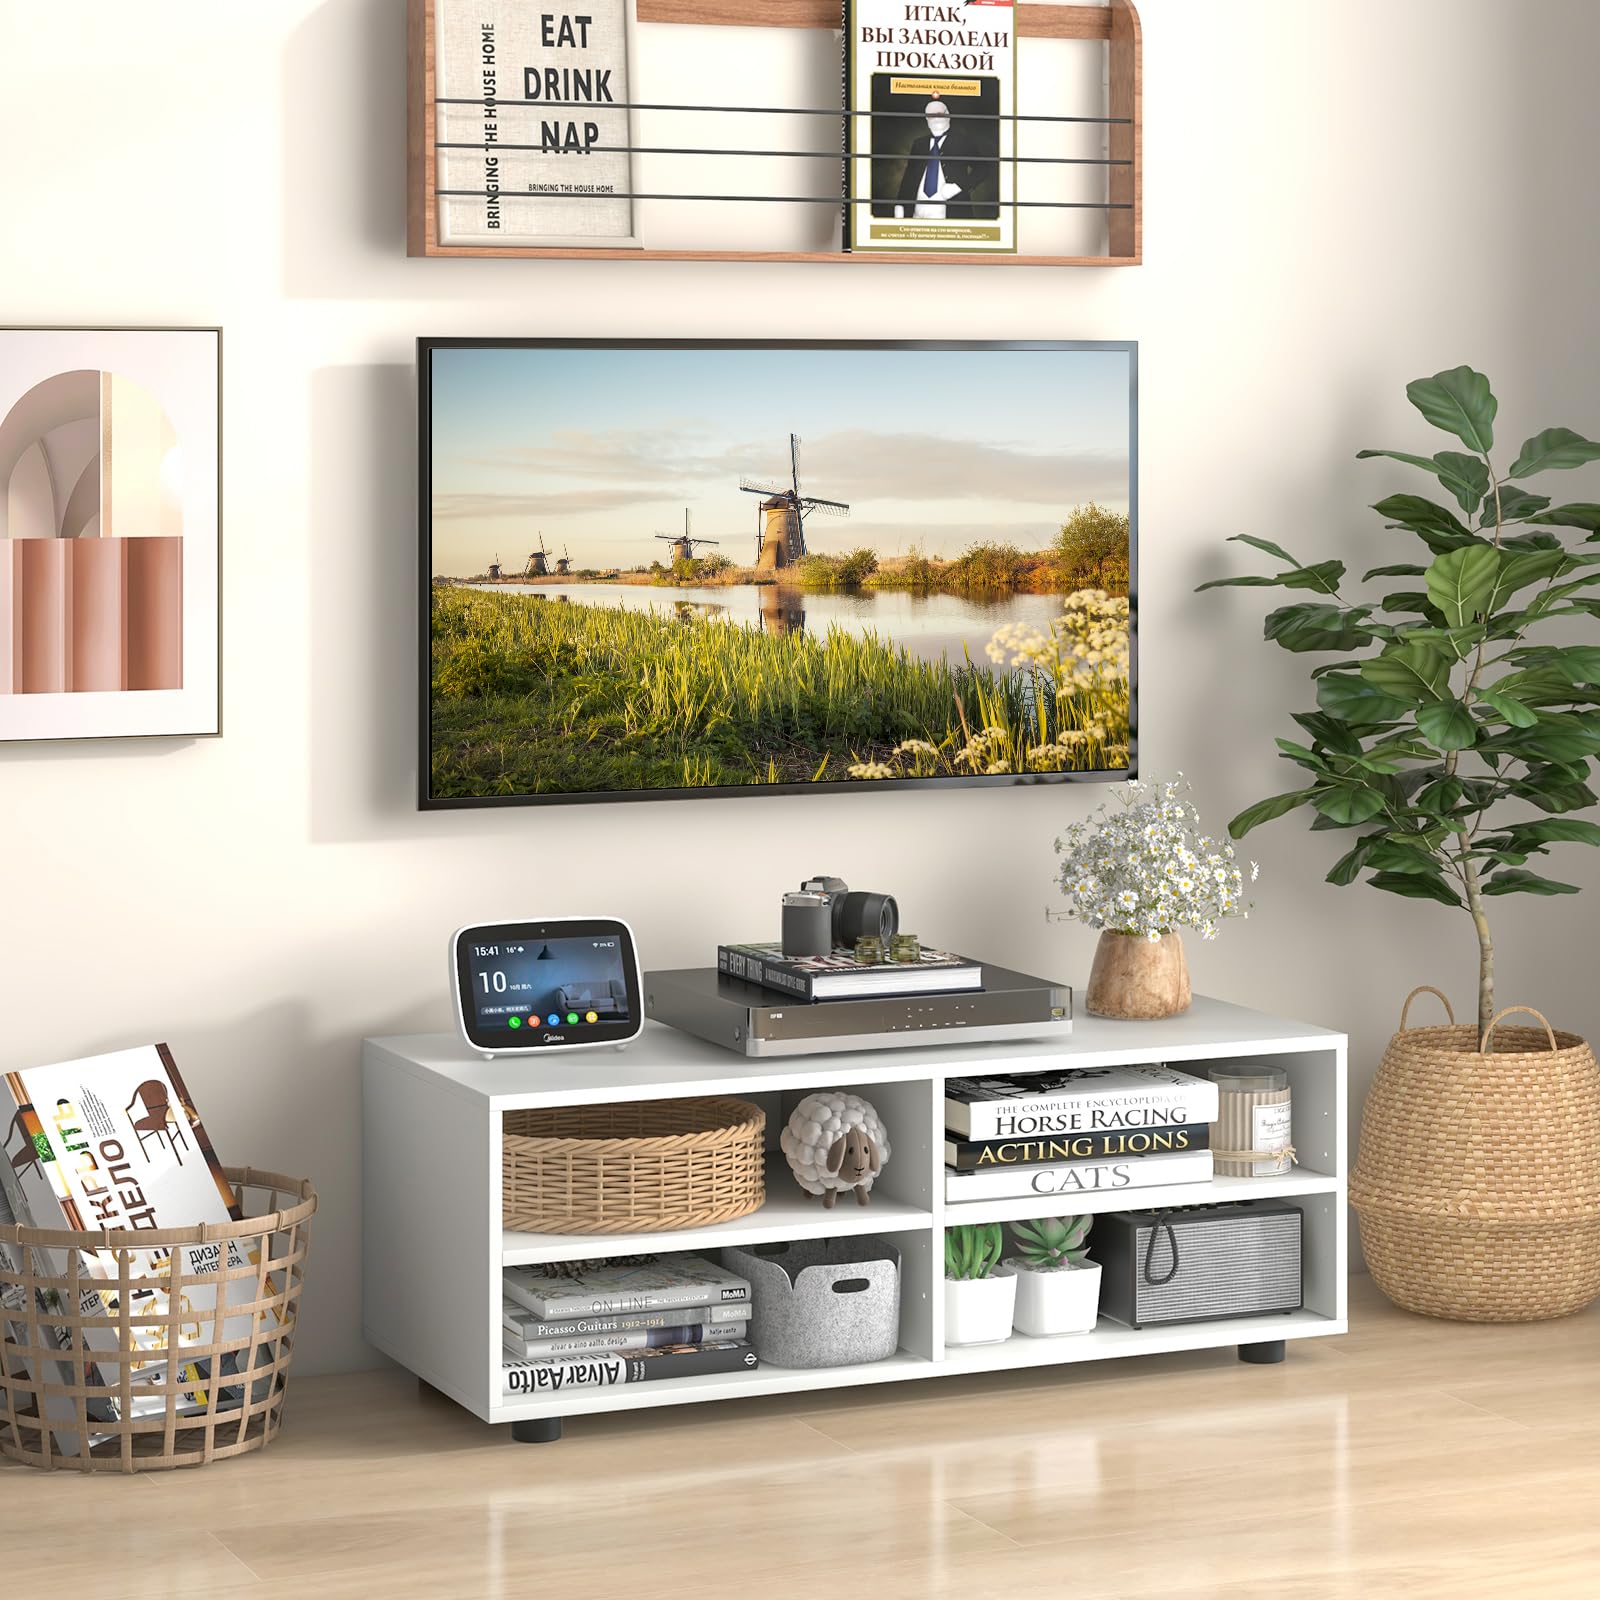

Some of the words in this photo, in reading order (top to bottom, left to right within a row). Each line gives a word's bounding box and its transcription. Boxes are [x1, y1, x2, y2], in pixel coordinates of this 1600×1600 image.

[904, 5, 967, 26] ИТАК,
[541, 14, 592, 48] EAT
[862, 27, 893, 44] ВЫ
[899, 28, 1009, 48] ЗАБОЛЕЛИ
[481, 23, 495, 64] HOME
[876, 51, 994, 71] ПРОКАЗОЙ
[483, 69, 497, 118] HOUSE
[524, 67, 613, 102] DRINK
[485, 123, 497, 152] THE
[541, 121, 599, 155] NAP
[485, 157, 500, 229] BRINGING
[528, 183, 559, 192] BRINGING
[560, 184, 573, 193] THE
[574, 185, 594, 193] HOUSE
[596, 185, 614, 193] HOME
[474, 946, 499, 956] 15:41
[478, 971, 507, 993] 10
[995, 1105, 1019, 1116] THE
[1022, 1100, 1082, 1114] COMPLETE
[1086, 1095, 1170, 1109] ENCYCLOPEDIA
[995, 1113, 1082, 1136] HORSE
[1091, 1106, 1188, 1130] RACING
[977, 1138, 1095, 1166] ACTING
[1104, 1129, 1190, 1155] LIONS
[99, 1139, 158, 1231] ДЕЛО
[1030, 1163, 1132, 1194] CATS
[188, 1240, 238, 1266] ДИЗАН
[193, 1256, 243, 1275] ИНТЕРЕРА
[591, 1300, 614, 1314] ON
[620, 1295, 653, 1312] LINE
[722, 1288, 746, 1300] MoMA
[722, 1309, 747, 1319] MoMA
[537, 1322, 576, 1336] Picasso
[577, 1319, 618, 1333] Guitars
[551, 1342, 567, 1351] alvar
[573, 1340, 587, 1349] aino
[607, 1337, 628, 1346] design
